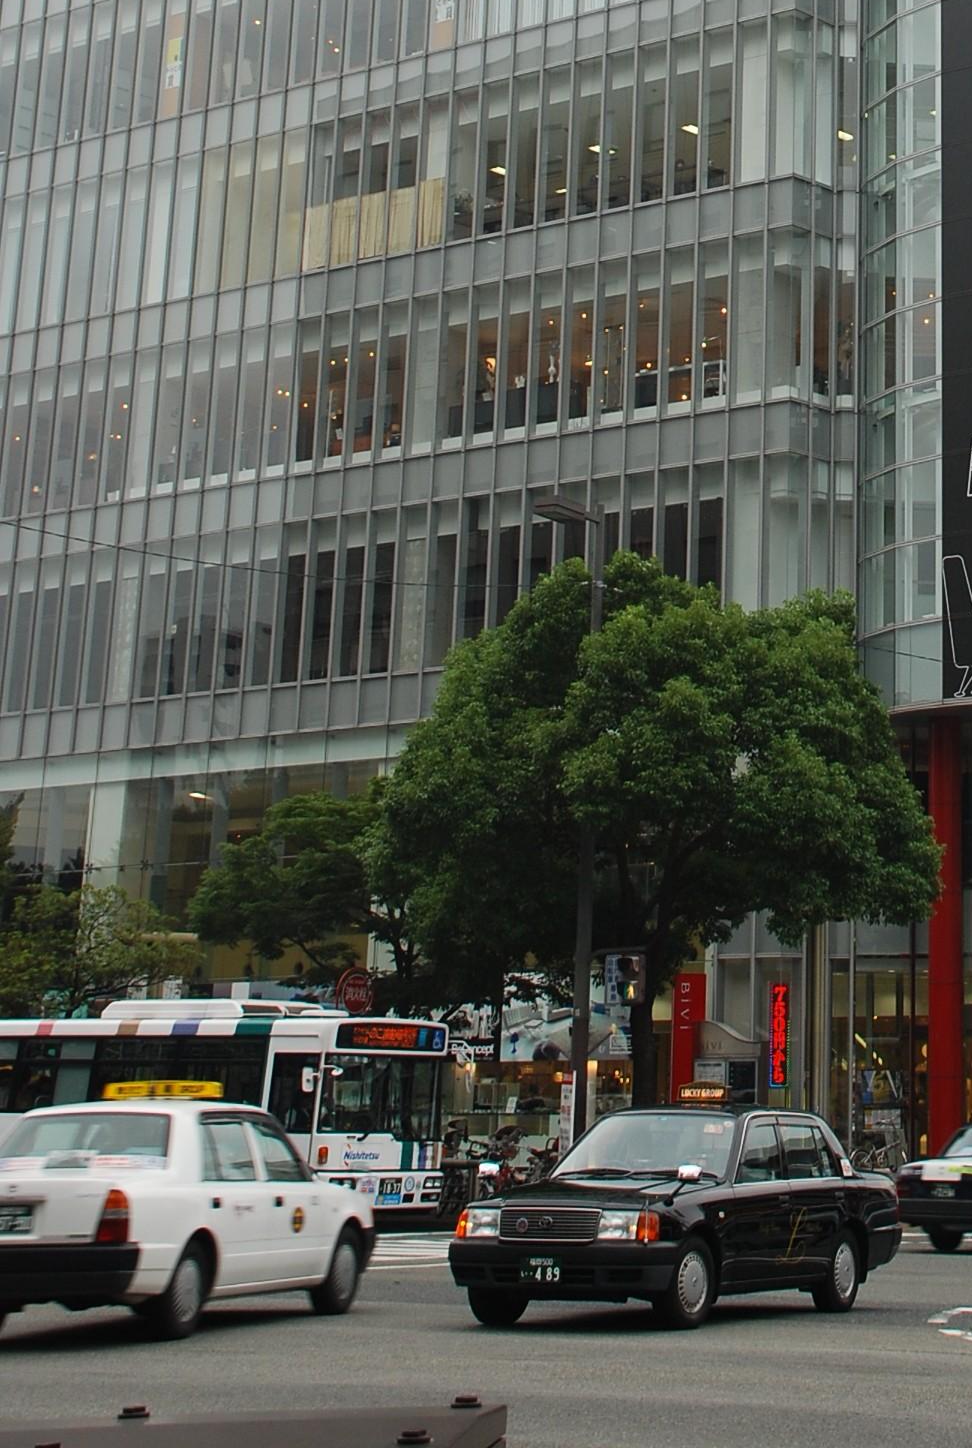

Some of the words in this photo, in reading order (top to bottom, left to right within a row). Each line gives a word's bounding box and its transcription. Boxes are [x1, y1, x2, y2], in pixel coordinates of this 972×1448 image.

[681, 1088, 700, 1098] LUCKY
[702, 1088, 724, 1098] GROUP
[343, 1152, 380, 1160] Nishitetsu
